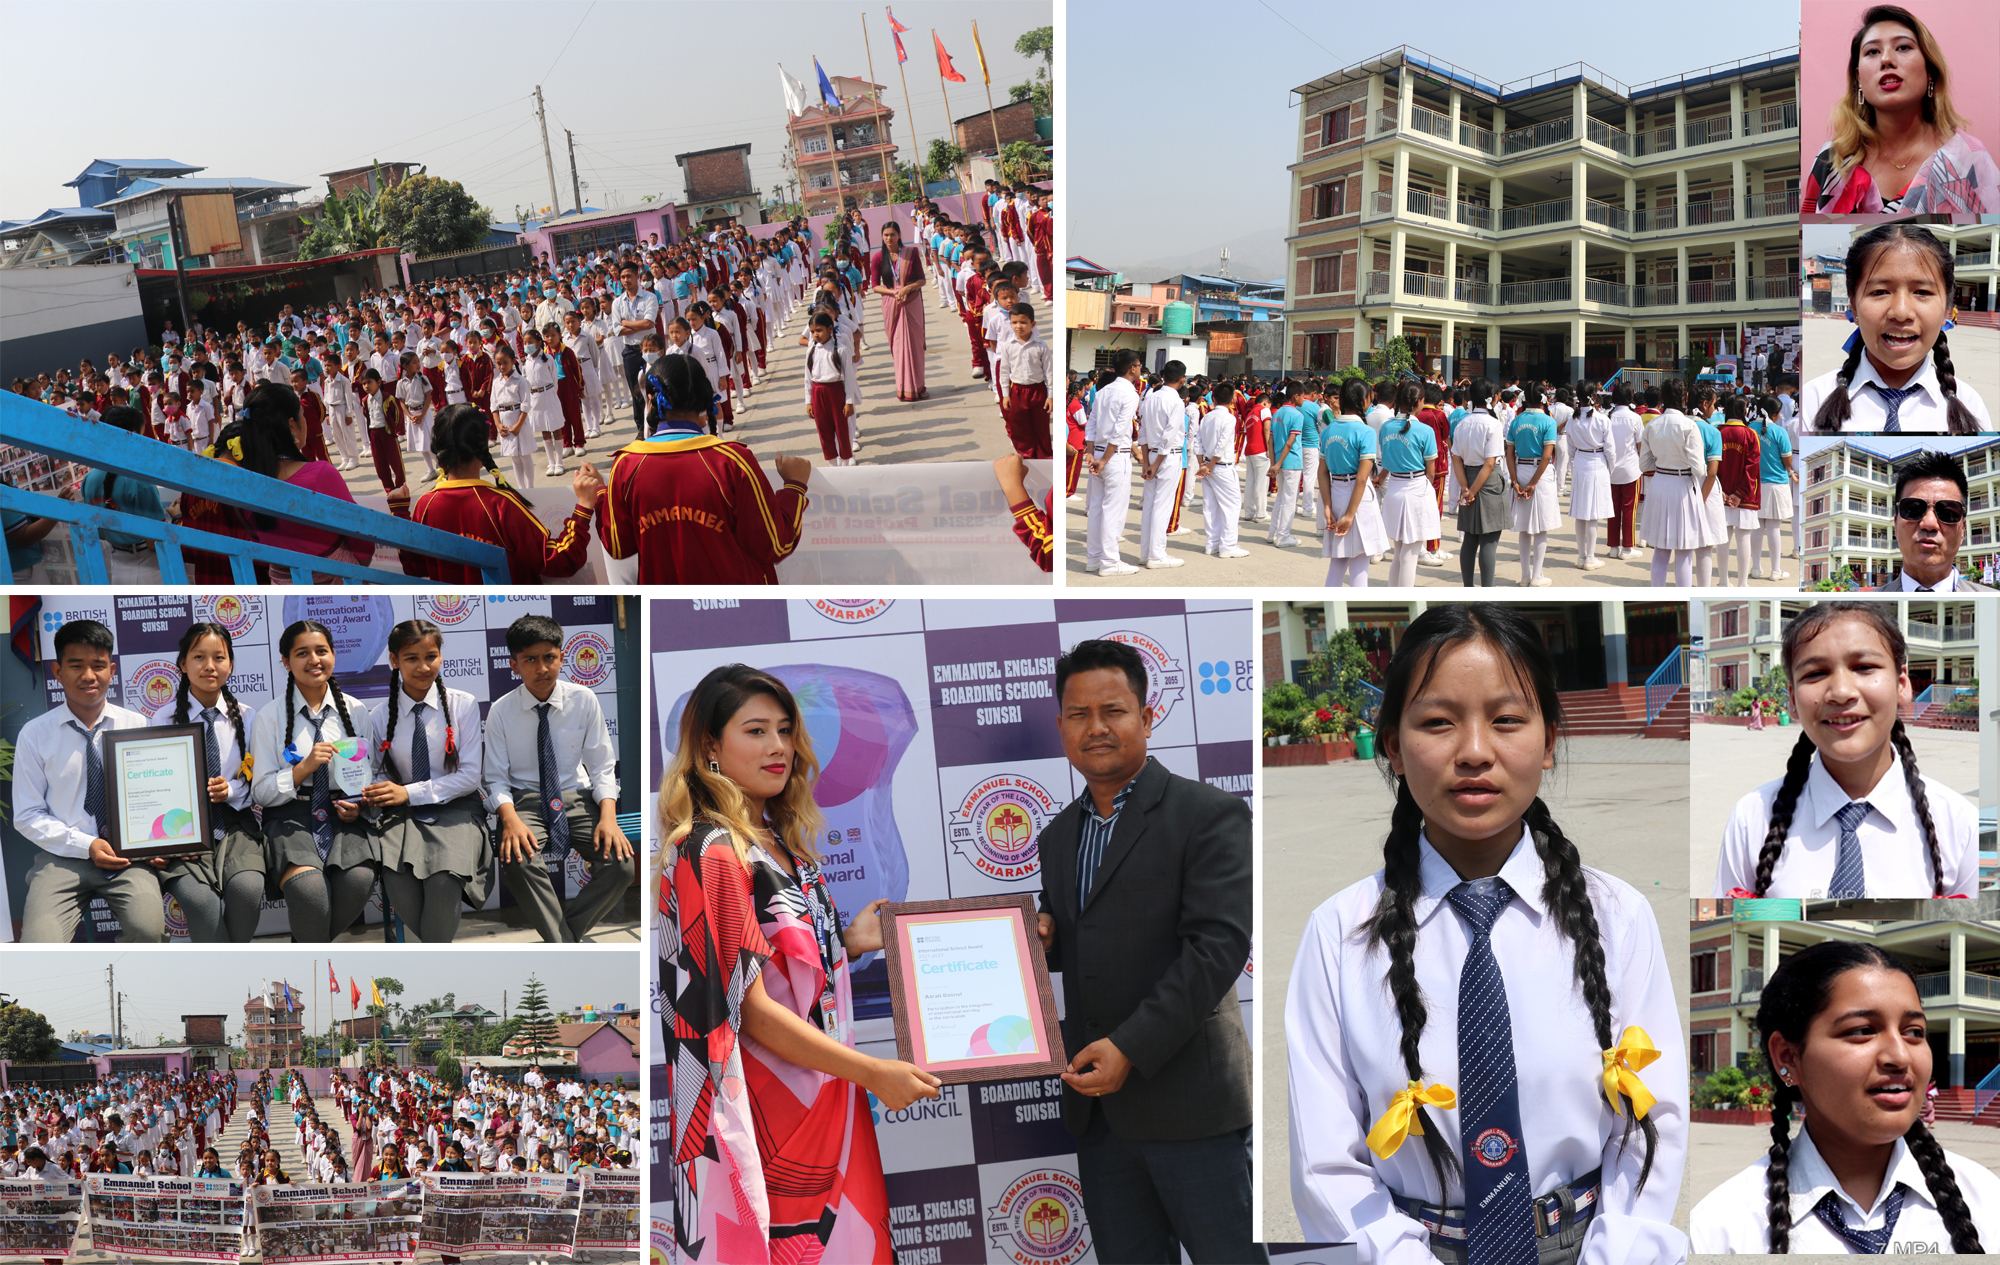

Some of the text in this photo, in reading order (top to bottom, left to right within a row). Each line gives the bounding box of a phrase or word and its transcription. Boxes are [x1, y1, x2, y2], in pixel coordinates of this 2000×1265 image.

[637, 505, 725, 535] EMMANUEL
[117, 595, 188, 608] EMMANUEL ENGLISH
[307, 604, 366, 617] International
[573, 596, 596, 606] SUNSRI
[65, 609, 107, 620] BRITISH
[122, 607, 187, 621] BOARDING SCHOOL
[342, 613, 371, 624] Award
[430, 608, 470, 624] DHARAN-17
[142, 621, 168, 632] SUNSRI
[564, 633, 609, 655] EMMANUEL SCHOOL
[1132, 635, 1169, 668] SCHOOL
[443, 658, 481, 669] BRITISH
[443, 667, 484, 678] COUNCIL
[933, 657, 1056, 683] EMMANUEL ENGLISH
[132, 662, 162, 685] EMMANUEL
[1164, 676, 1179, 685] 2055
[941, 680, 1053, 705] BOARDING SCHOOL
[976, 705, 1022, 726] SUNSRI
[127, 768, 174, 780] Certificate
[962, 778, 1053, 818] EMMANUEL SCHOOL
[979, 800, 992, 819] FEAR
[991, 795, 1000, 803] OF
[1016, 794, 1034, 812] LORD
[1031, 808, 1039, 816] IS
[953, 828, 971, 837] ESTD.
[978, 836, 1010, 861] BEGINNING
[1010, 853, 1020, 861] OF
[823, 865, 866, 884] ward
[921, 959, 998, 975] Certificate
[980, 1080, 1042, 1105] BOARDING
[885, 1102, 962, 1124] COUNCIL
[1015, 1101, 1061, 1123] SUNSRI
[1476, 1128, 1496, 1146] EMMANUEL
[103, 1178, 192, 1190] Emmanuel School
[440, 1177, 528, 1186] Emmanuel School
[594, 1173, 640, 1182] Emmanue
[272, 1186, 367, 1198] Emmanuel School
[1000, 1173, 1084, 1213] EMMANUEL SCHOO
[1479, 1171, 1516, 1209] EMMANUEL
[923, 1198, 975, 1220] ENGLISH
[1016, 1196, 1030, 1215] FEAR
[1029, 1189, 1038, 1198] OF
[1053, 1188, 1071, 1205] LORD
[925, 1221, 972, 1243] SCHOOL
[992, 1222, 1009, 1232] ESTD.
[1016, 1227, 1079, 1254] BEGINNING OF WISDOM
[897, 1246, 942, 1265] SUNSRI
[1014, 1239, 1087, 1265] DHARAN-17
